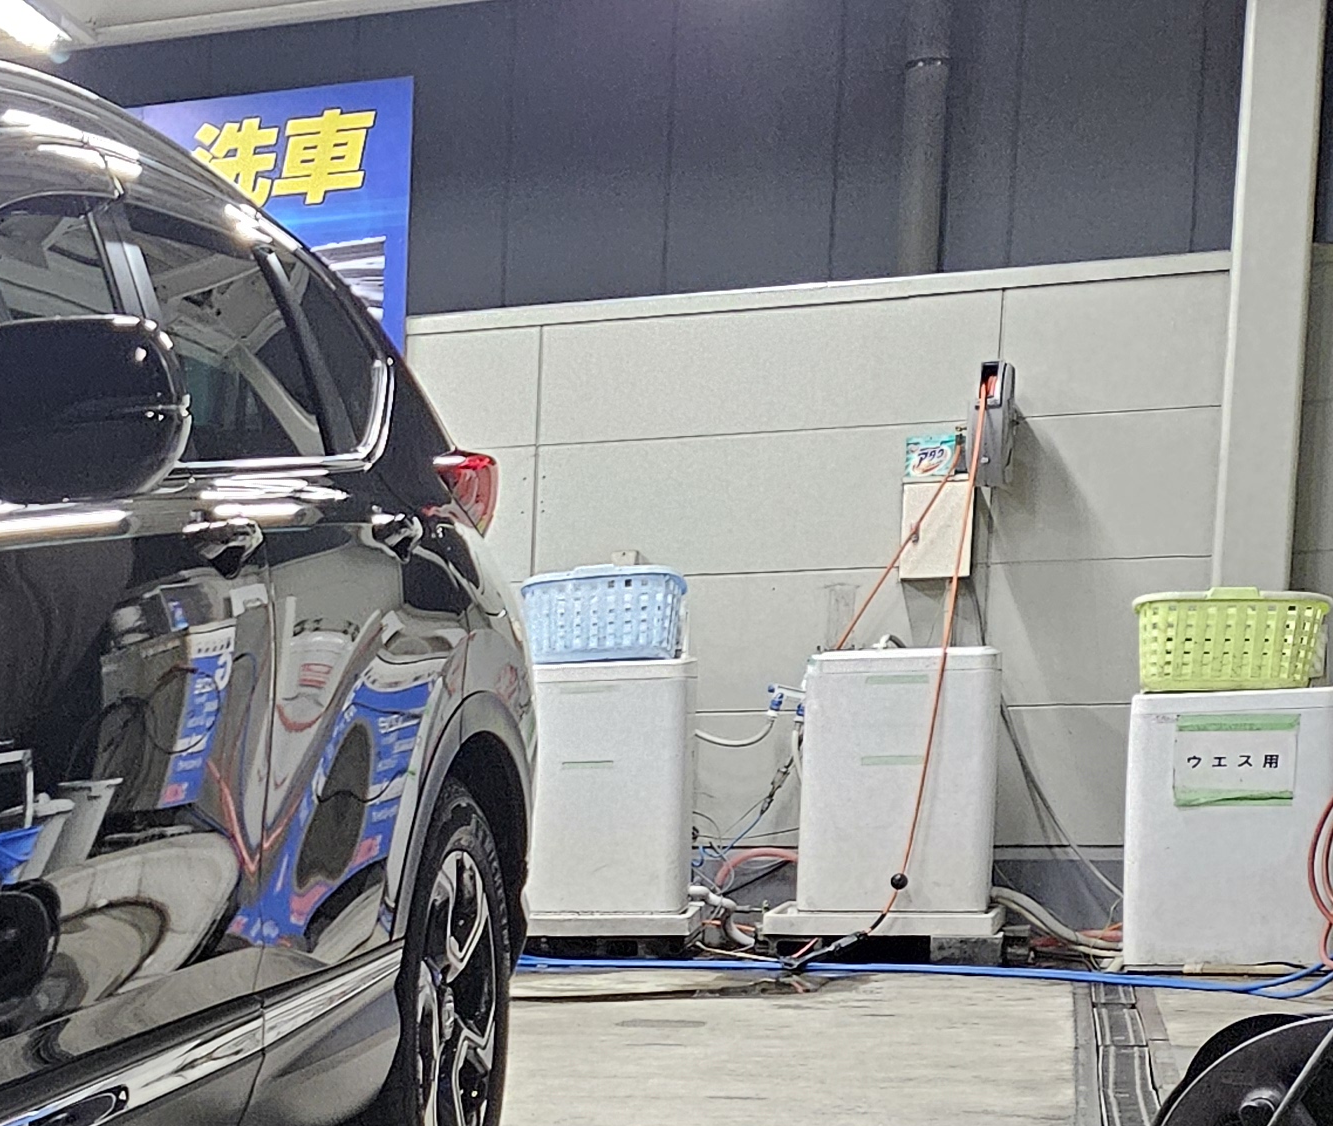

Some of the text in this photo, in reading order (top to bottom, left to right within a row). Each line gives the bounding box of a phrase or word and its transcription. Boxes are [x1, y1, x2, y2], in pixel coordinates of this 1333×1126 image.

[191, 107, 378, 208] 洗車
[1186, 754, 1280, 769] ウエス用
